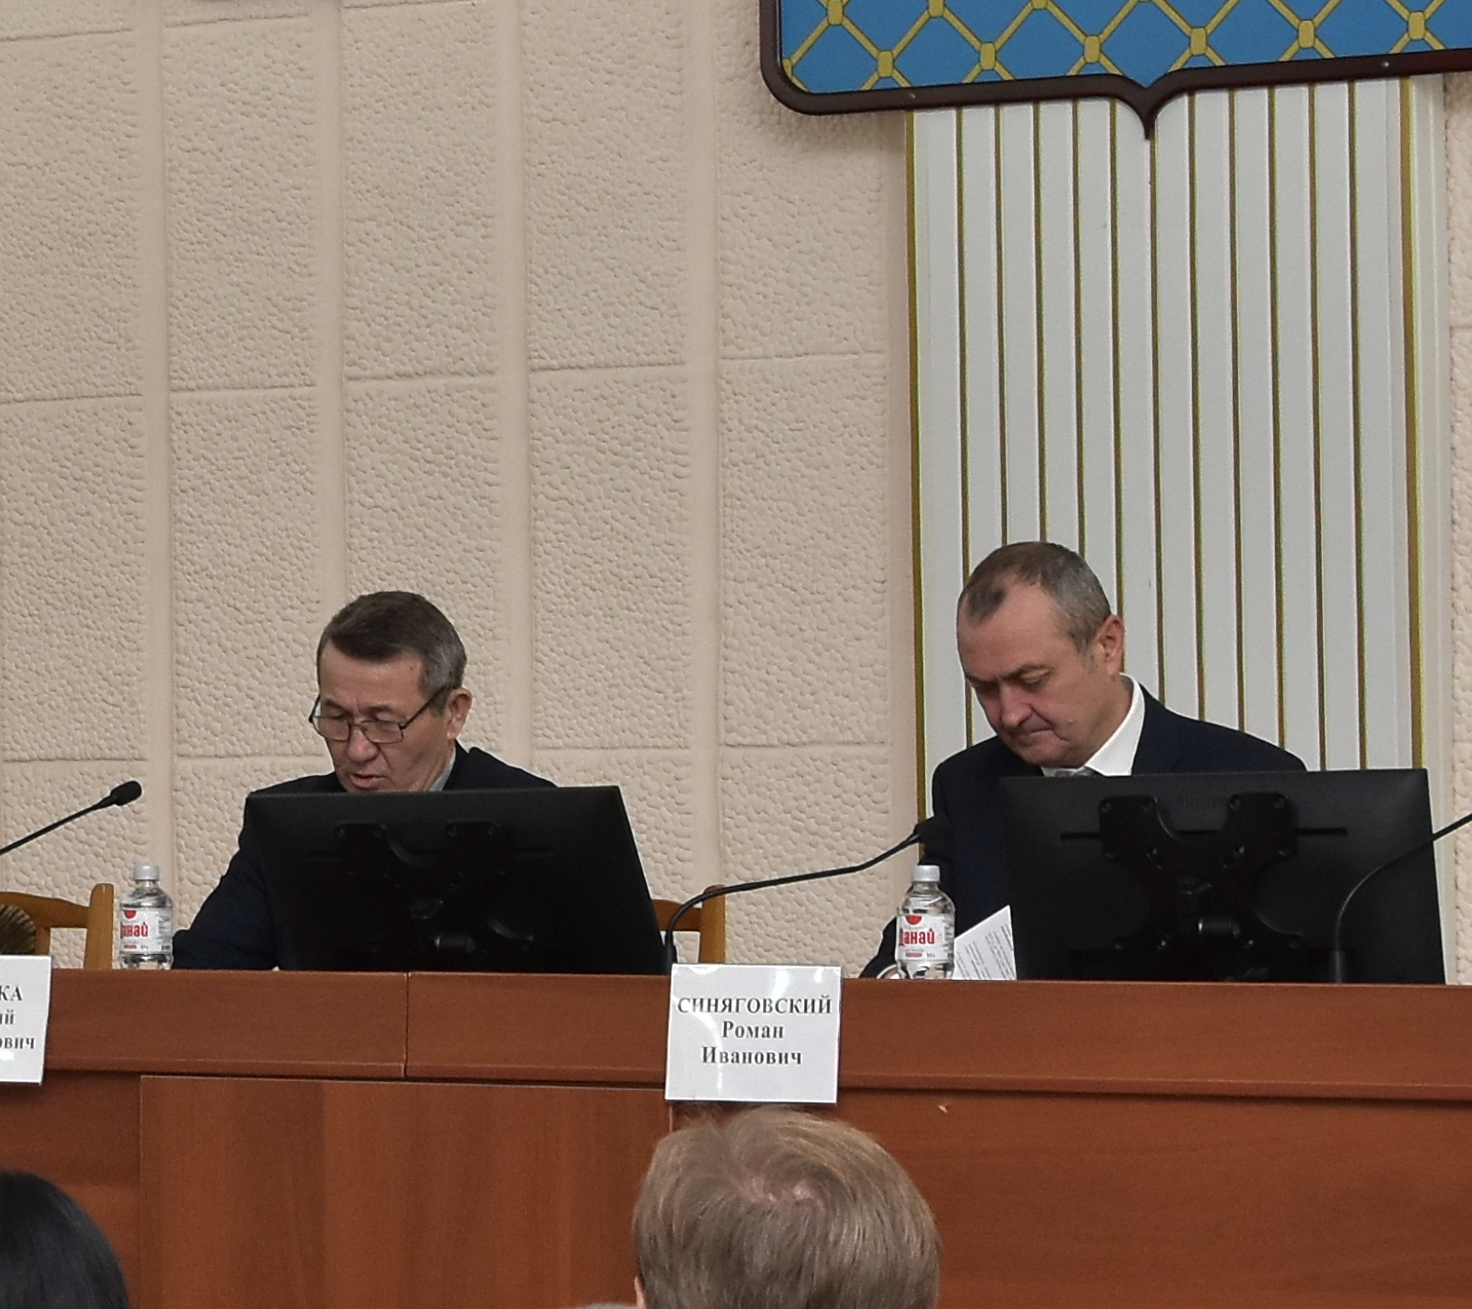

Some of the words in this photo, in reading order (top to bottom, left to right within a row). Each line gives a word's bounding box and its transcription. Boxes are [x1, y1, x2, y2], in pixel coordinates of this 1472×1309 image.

[677, 995, 832, 1015] СИНЯГОВСКИЙ
[722, 1021, 784, 1039] Роман
[701, 1046, 803, 1065] Иванович
